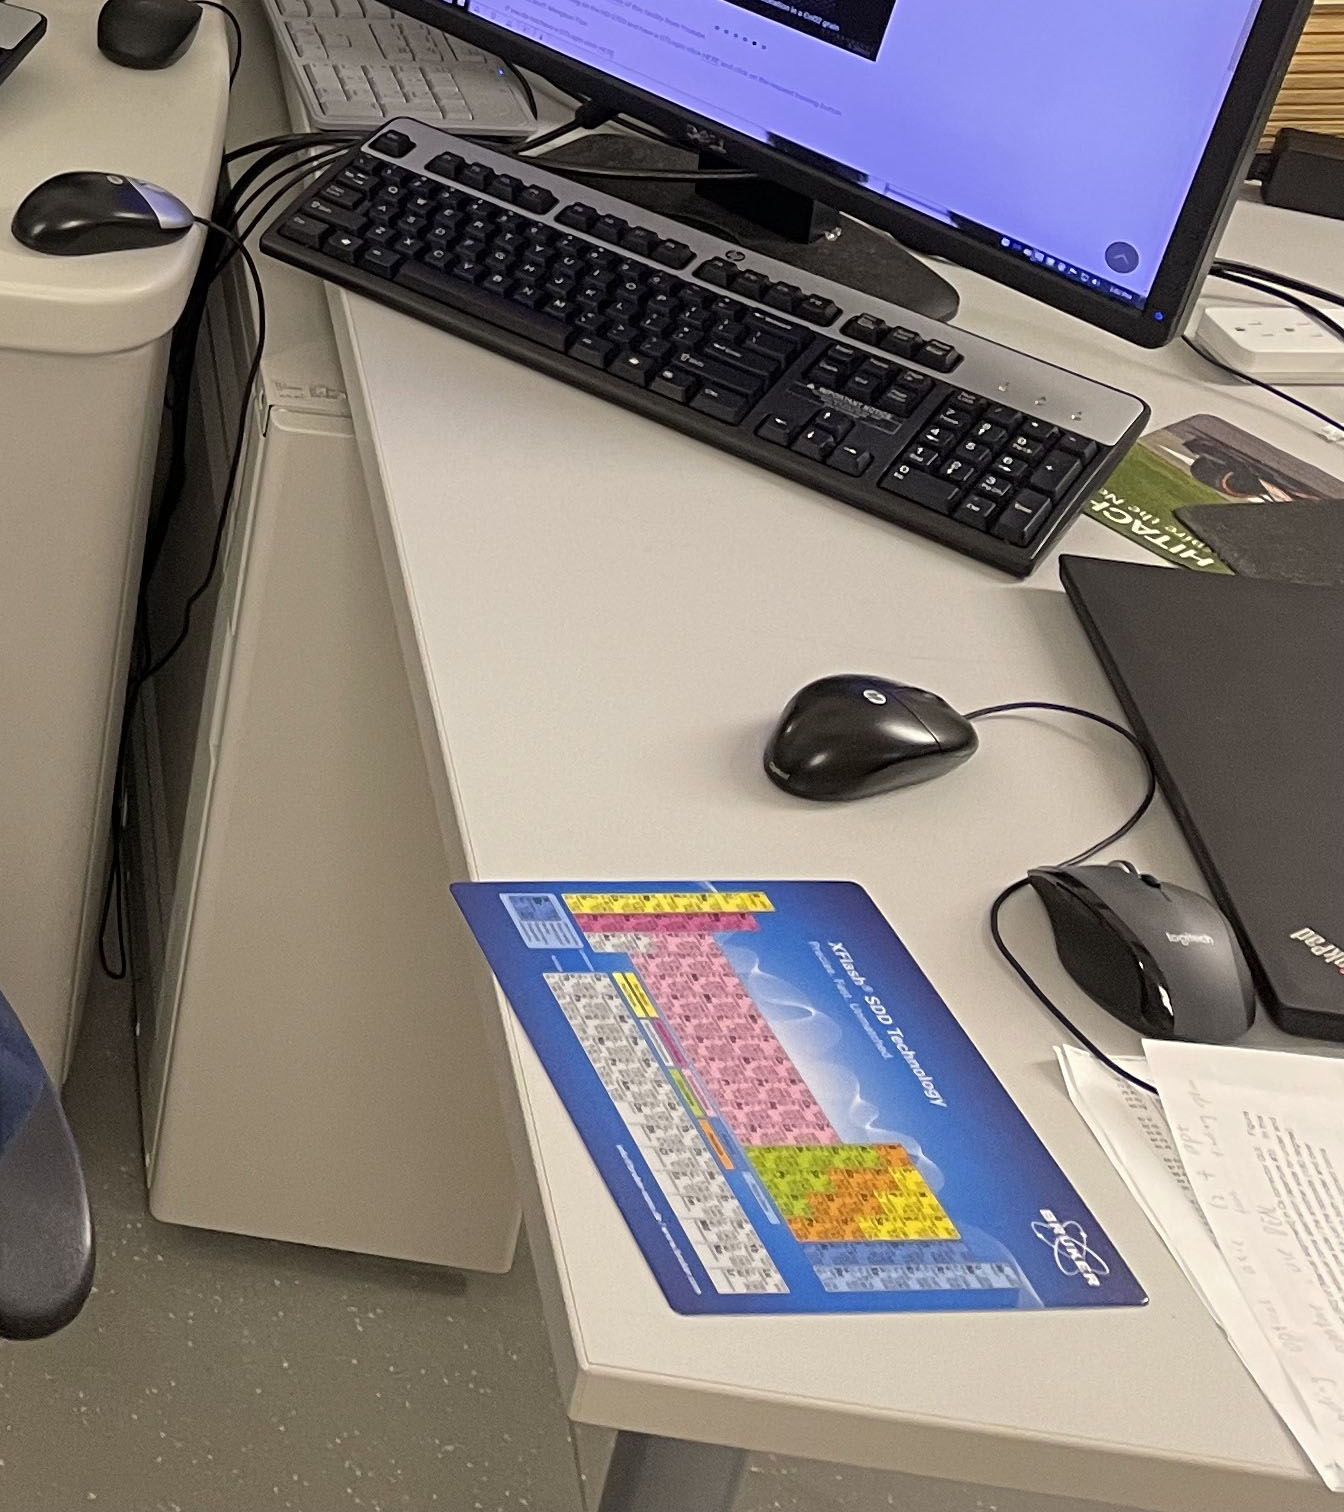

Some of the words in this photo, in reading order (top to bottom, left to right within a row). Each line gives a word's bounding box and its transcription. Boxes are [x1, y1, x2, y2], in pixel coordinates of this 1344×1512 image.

[1128, 505, 1160, 525] the
[1166, 932, 1214, 946] logitech
[1289, 927, 1344, 974] nkPad
[865, 995, 893, 1025] SDD
[887, 1027, 948, 1107] Technology
[1039, 1209, 1100, 1286] BRUKER
